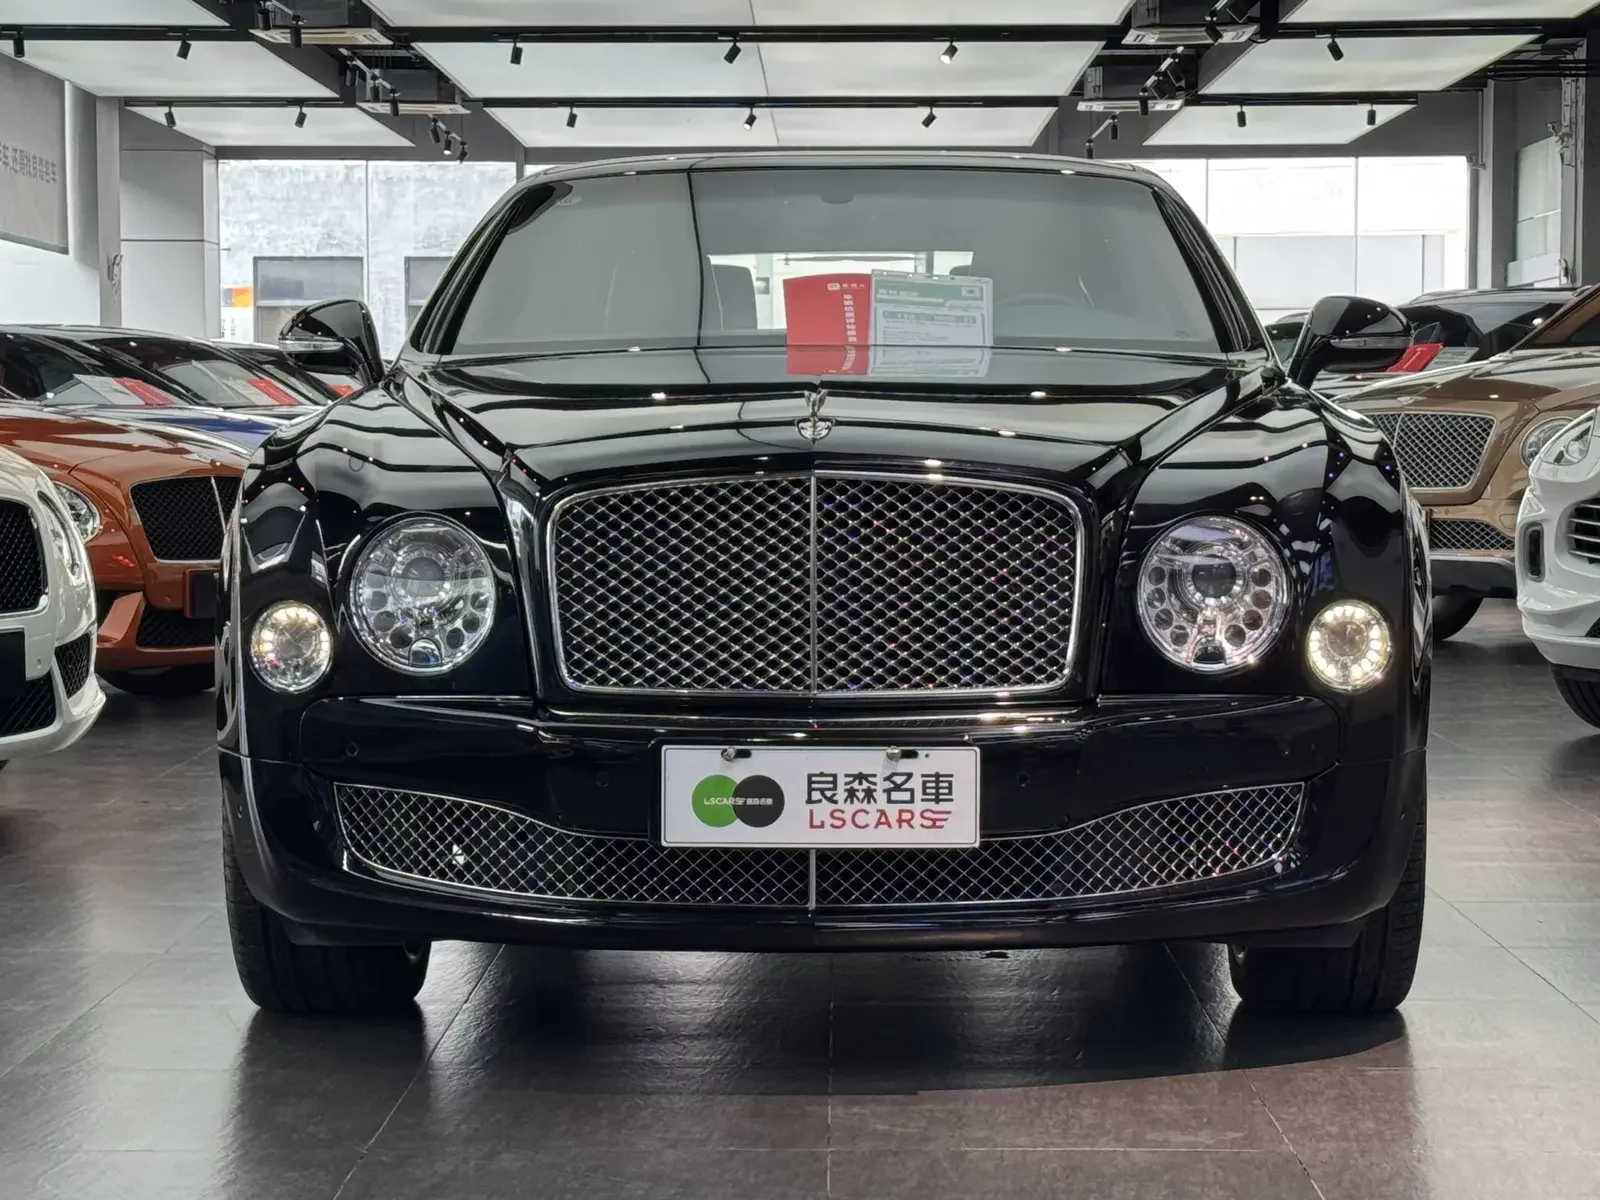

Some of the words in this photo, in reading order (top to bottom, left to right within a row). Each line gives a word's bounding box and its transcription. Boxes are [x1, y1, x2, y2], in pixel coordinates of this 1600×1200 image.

[805, 772, 954, 804] 良森名車
[704, 797, 745, 805] LSCARS
[808, 808, 953, 829] LSCARS
